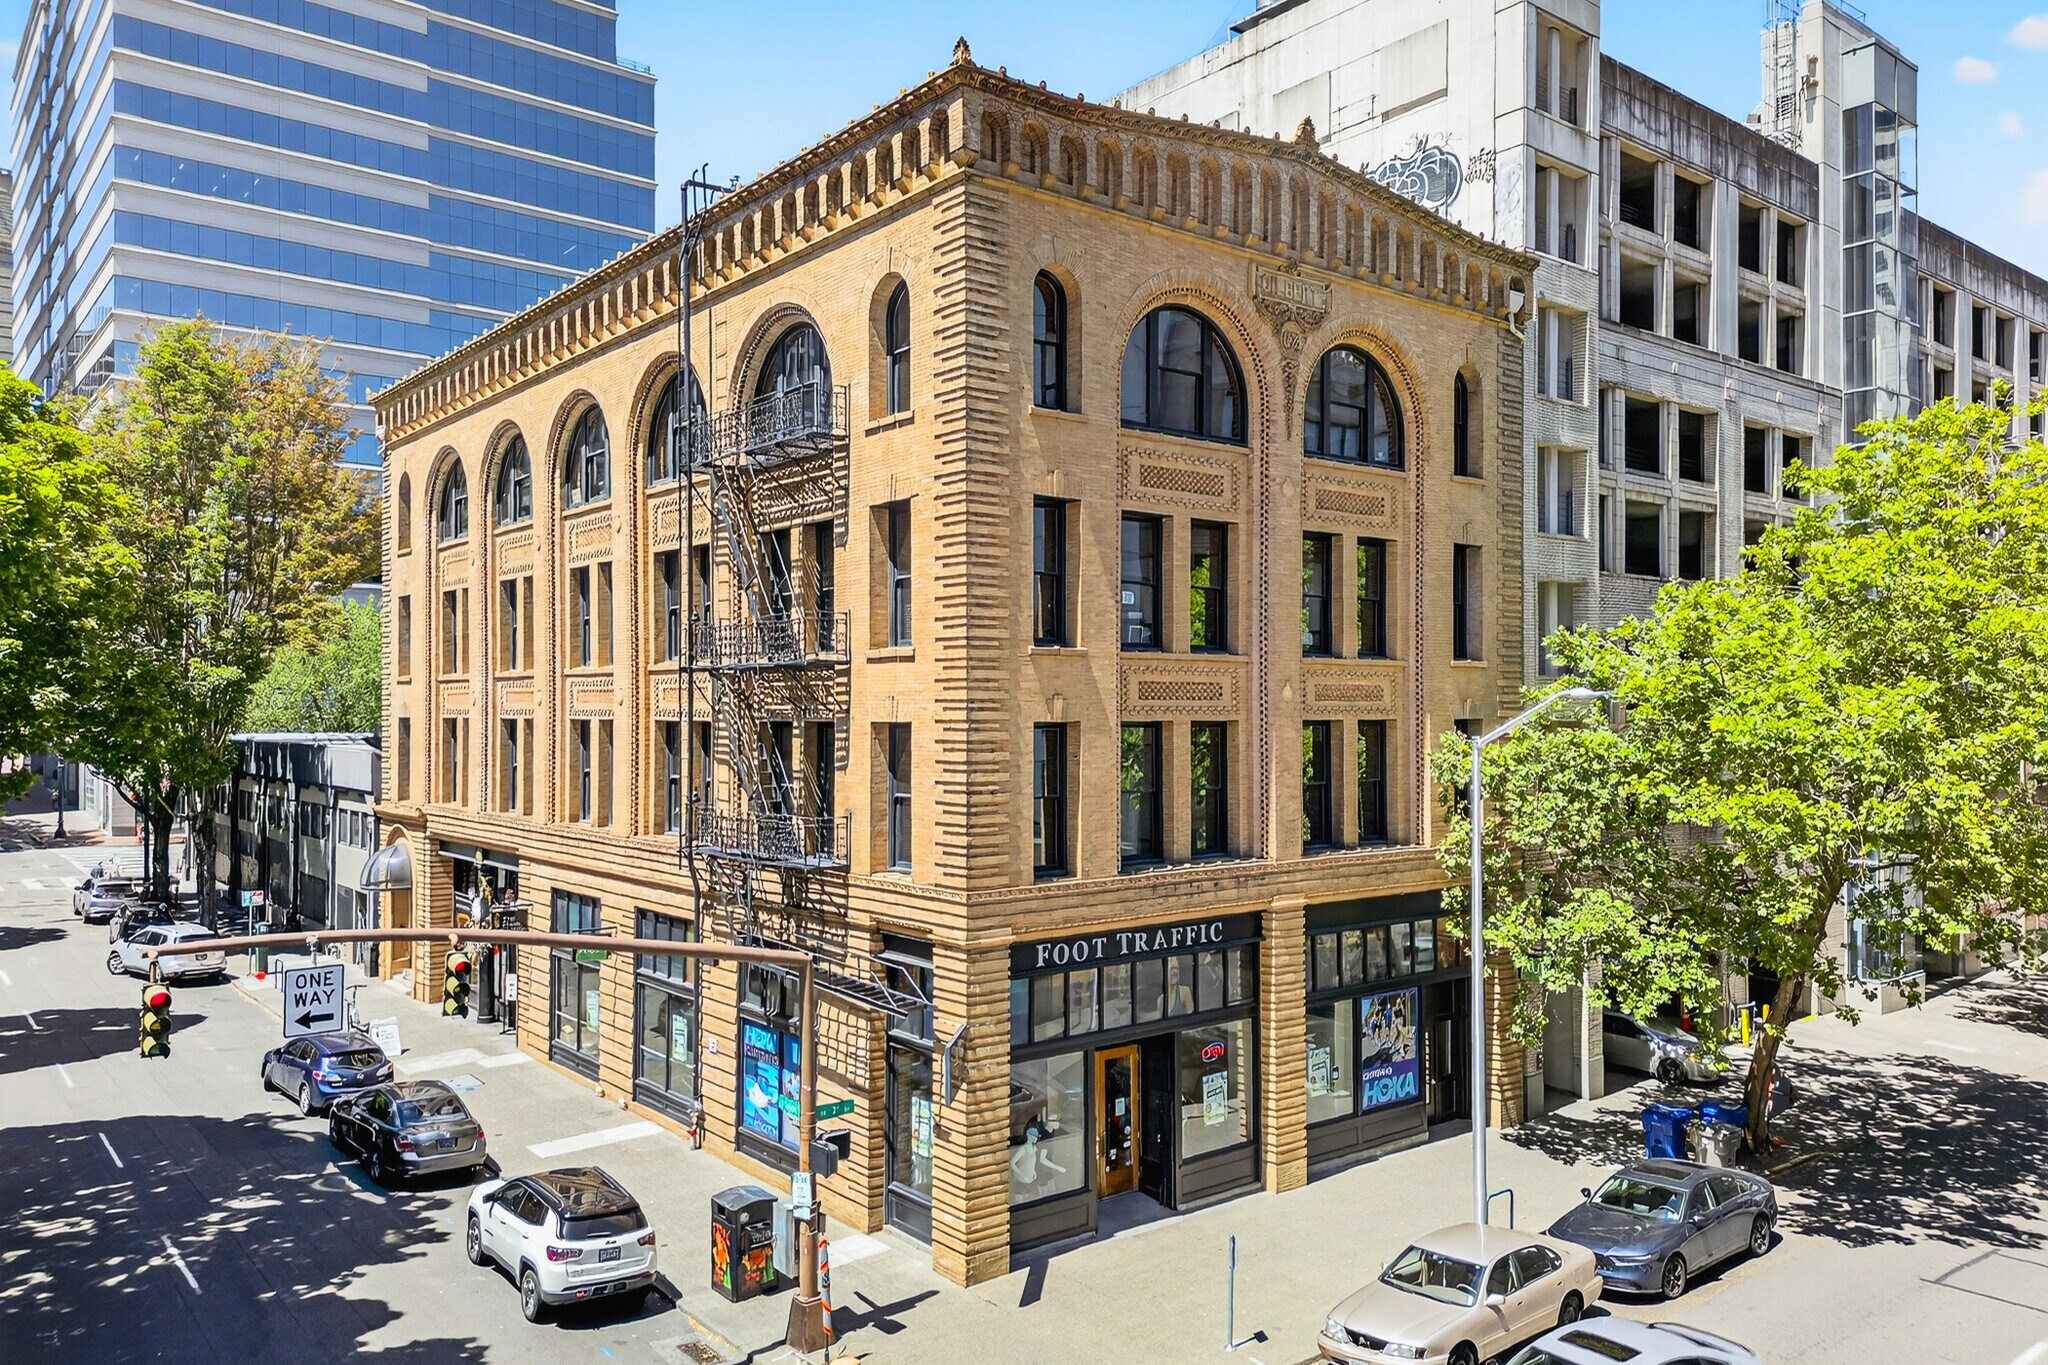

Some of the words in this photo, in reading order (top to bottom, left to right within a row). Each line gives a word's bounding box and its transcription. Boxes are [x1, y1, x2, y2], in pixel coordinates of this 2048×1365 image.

[1035, 937, 1107, 968] FOOT
[1116, 922, 1223, 955] TRAFFIC
[295, 971, 334, 989] ONE
[294, 989, 335, 1008] WAY
[1362, 1071, 1416, 1110] HOKA
